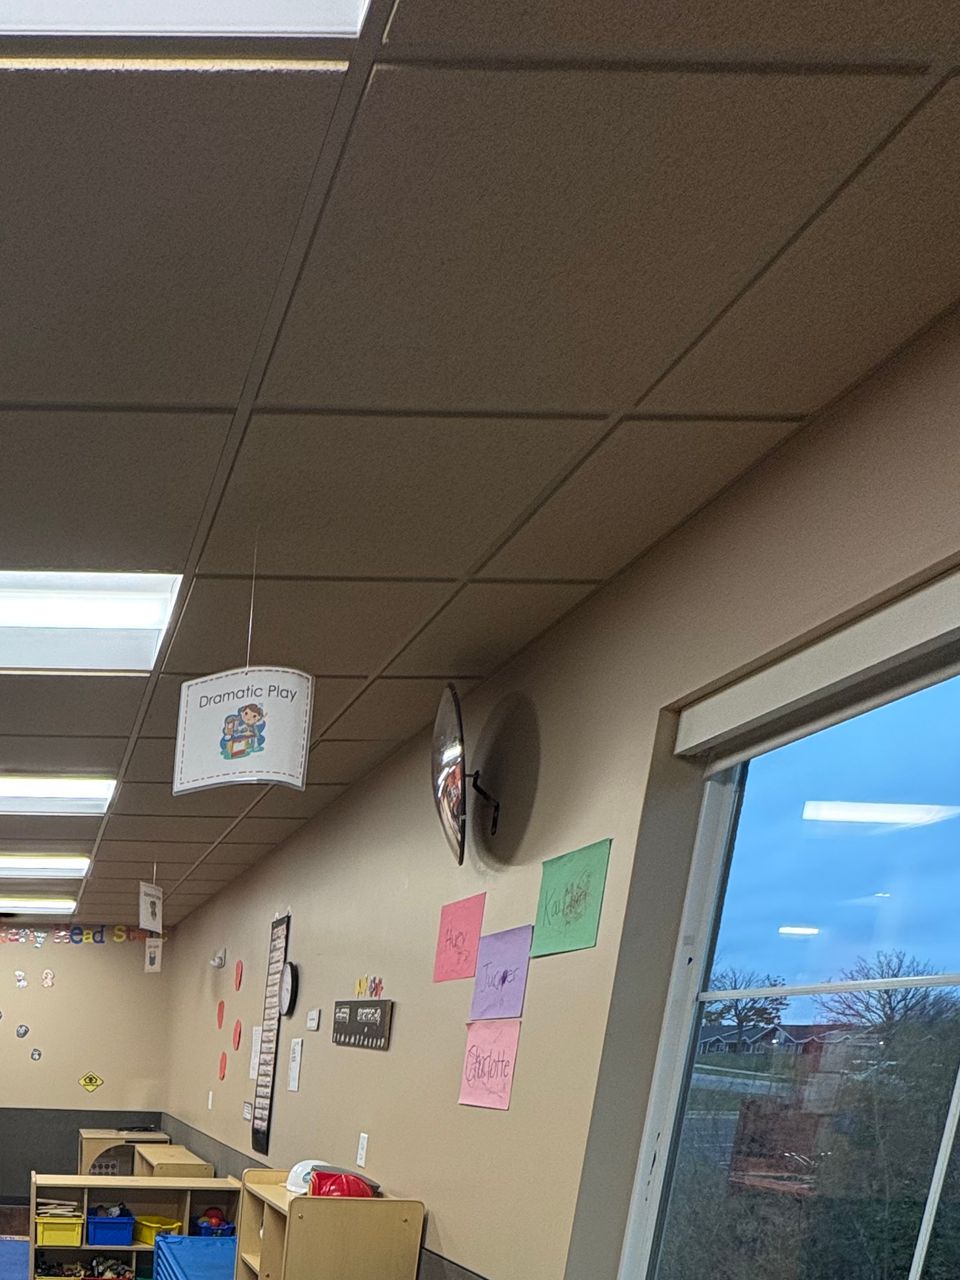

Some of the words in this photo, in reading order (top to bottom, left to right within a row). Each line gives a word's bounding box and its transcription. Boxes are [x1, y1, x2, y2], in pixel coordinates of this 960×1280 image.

[199, 684, 263, 708] Dramatic
[267, 684, 297, 702] Play
[54, 924, 106, 945] Head
